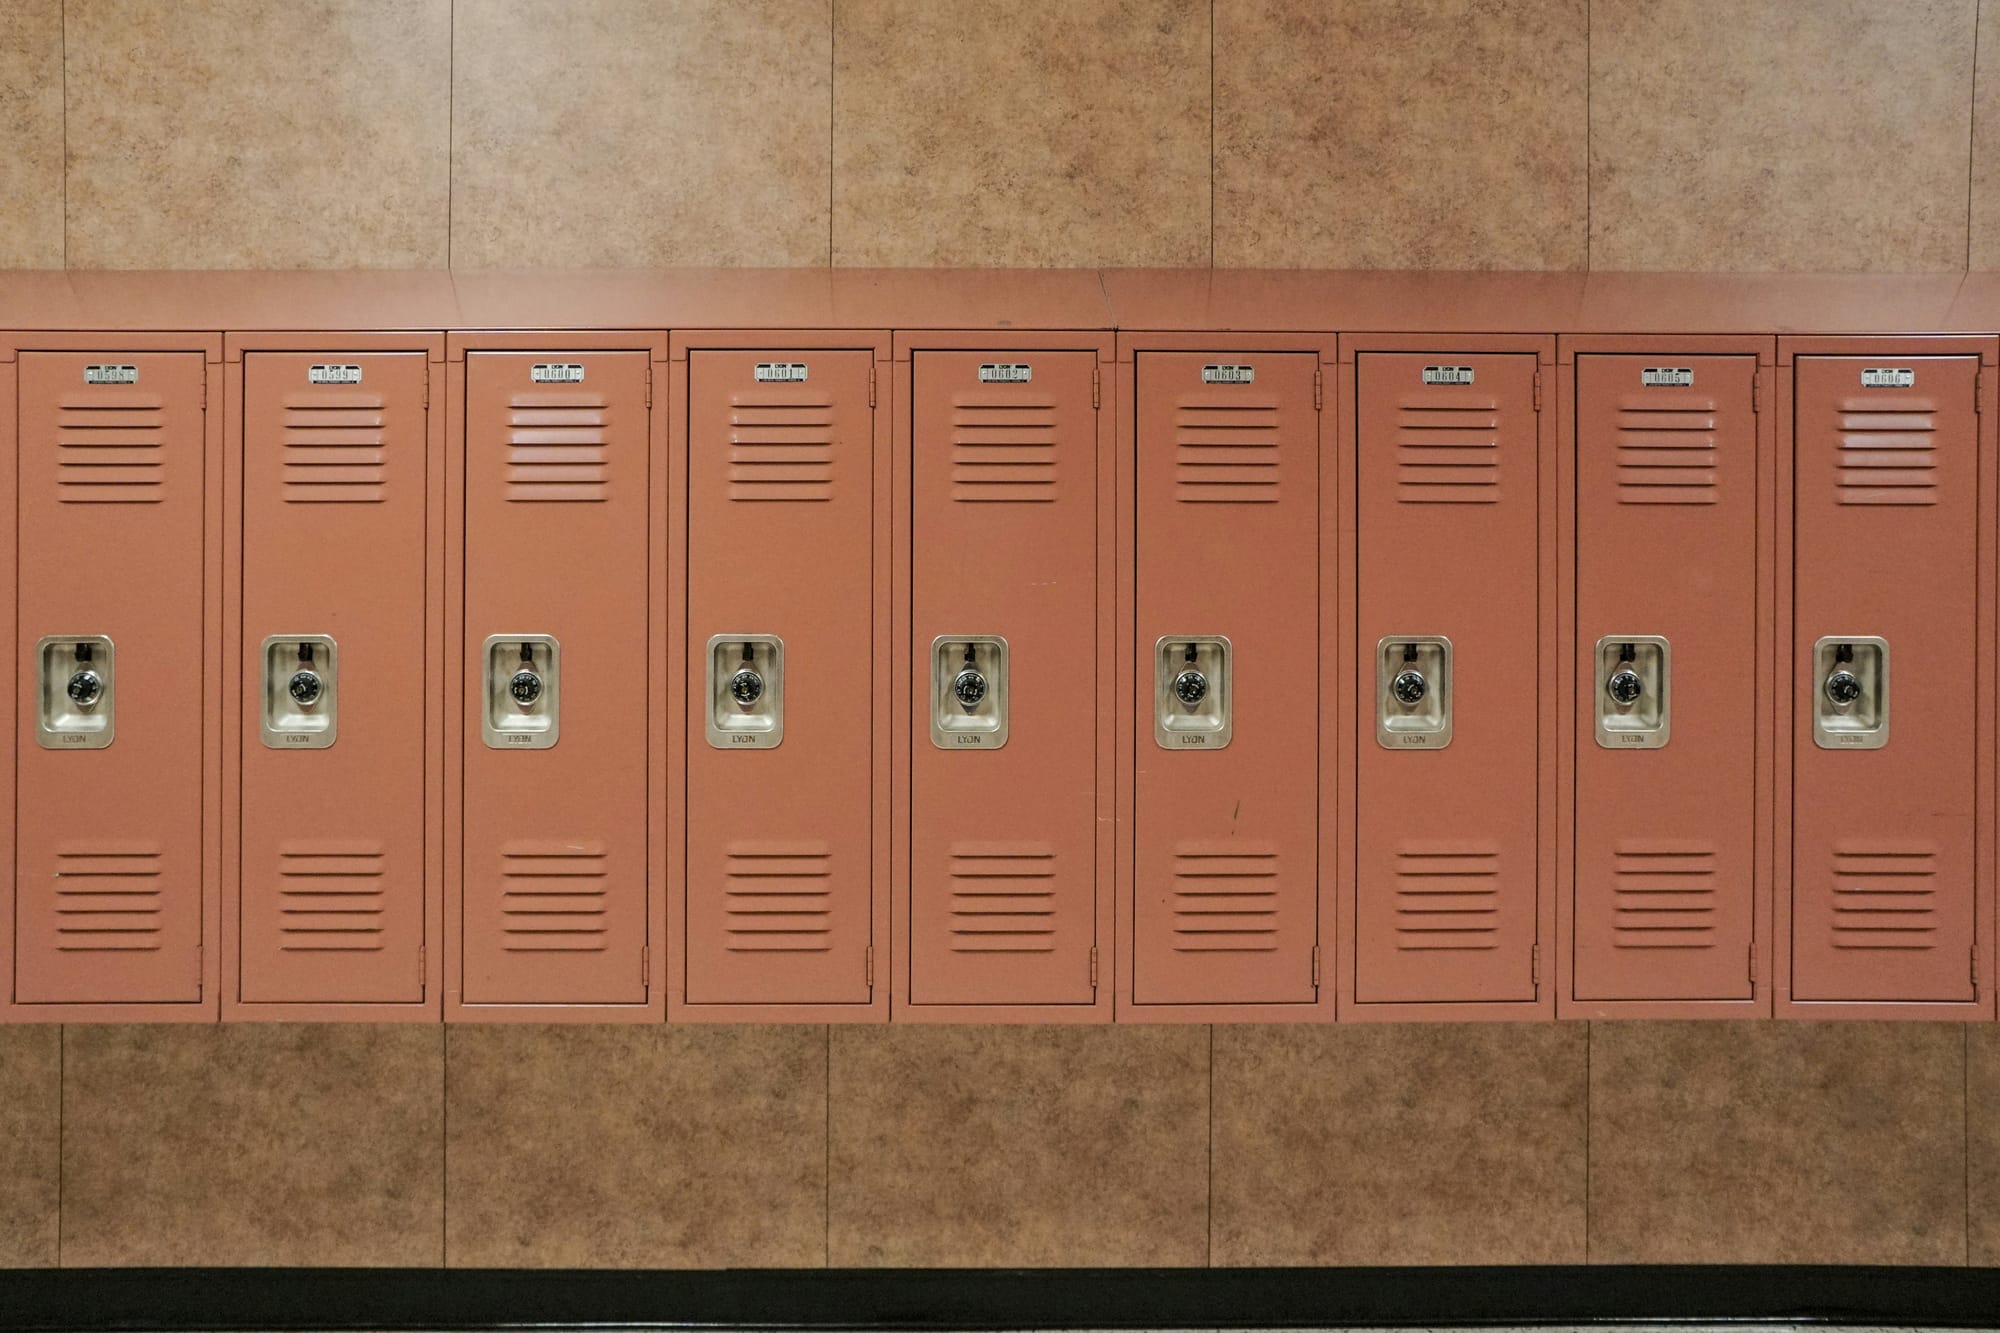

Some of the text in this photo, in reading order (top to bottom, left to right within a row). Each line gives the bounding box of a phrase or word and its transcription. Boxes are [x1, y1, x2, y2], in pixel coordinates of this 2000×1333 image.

[321, 370, 348, 379] 0599
[544, 369, 571, 379] 0600
[767, 369, 793, 378] 0601
[991, 369, 1018, 379] 0602
[1435, 372, 1461, 381] 0604
[1654, 373, 1681, 383] 0605
[732, 735, 756, 744] LYON
[957, 735, 981, 744] LYON
[1181, 735, 1205, 744] LYON
[1403, 735, 1426, 744] LYON
[1621, 735, 1644, 744] LYON
